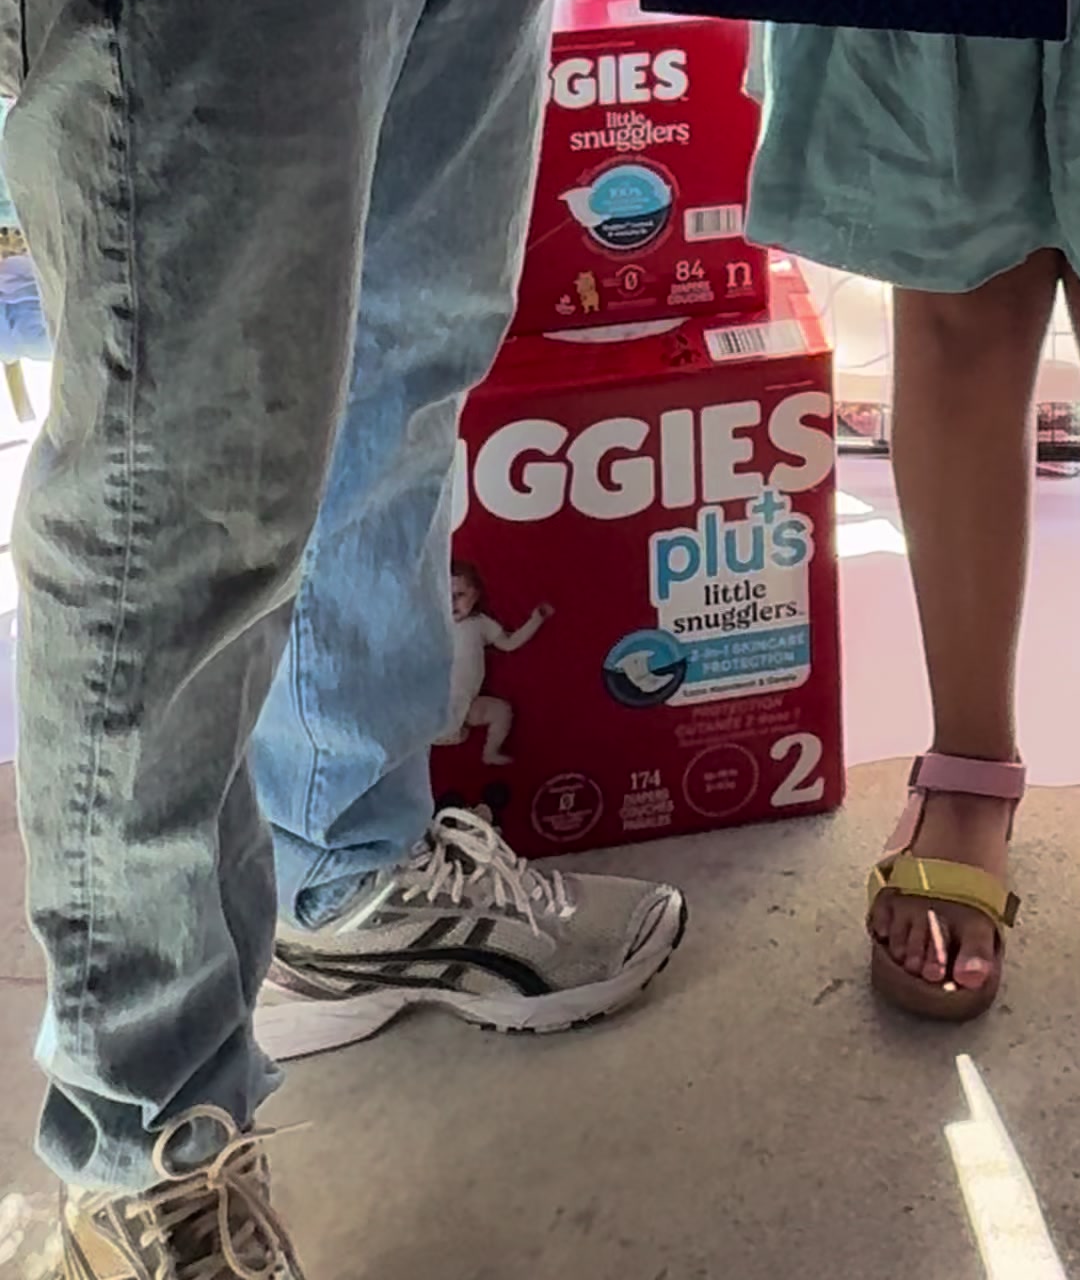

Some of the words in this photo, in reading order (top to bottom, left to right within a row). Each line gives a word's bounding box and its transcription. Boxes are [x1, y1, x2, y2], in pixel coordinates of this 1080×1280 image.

[550, 49, 689, 109] GIES
[606, 111, 646, 130] little
[570, 121, 690, 152] snugglers
[676, 259, 705, 281] 84
[726, 261, 752, 287] n
[656, 513, 807, 600] plus
[704, 580, 767, 606] little
[673, 601, 798, 634] snugglers
[731, 631, 805, 656] SKINCARE
[702, 651, 796, 674] PROTECTION
[630, 769, 661, 790] 174
[770, 732, 825, 807] 2
